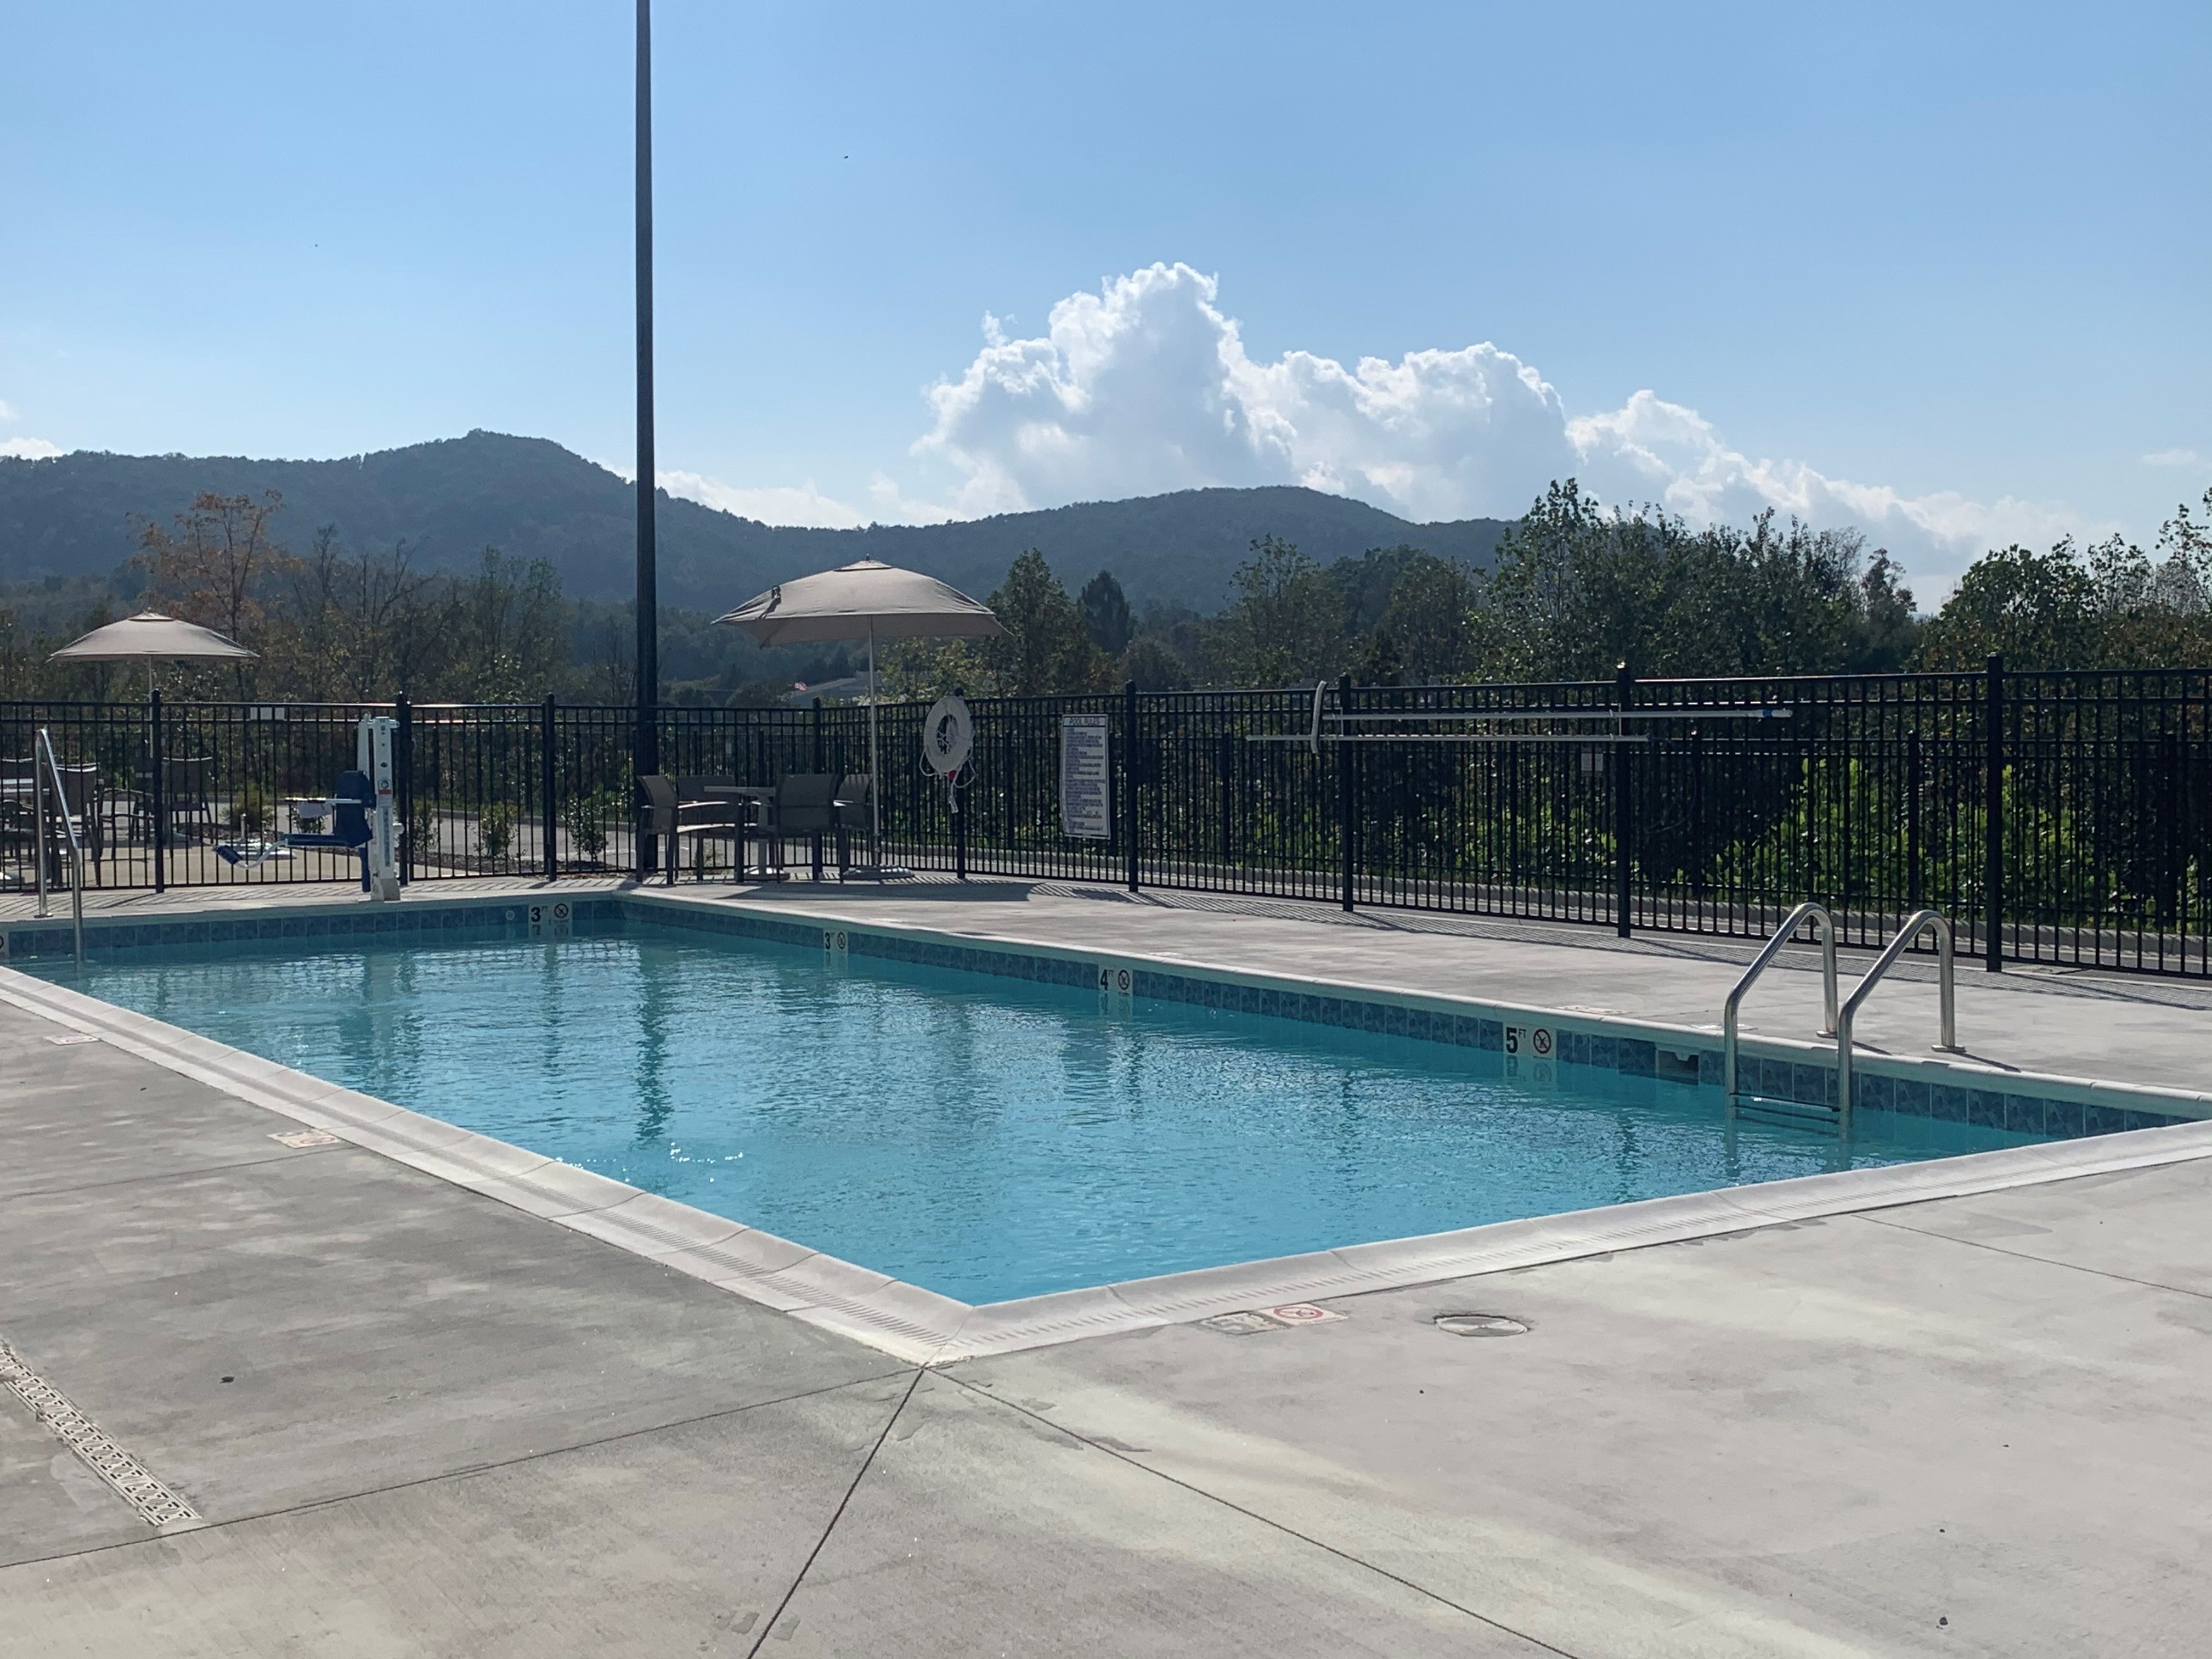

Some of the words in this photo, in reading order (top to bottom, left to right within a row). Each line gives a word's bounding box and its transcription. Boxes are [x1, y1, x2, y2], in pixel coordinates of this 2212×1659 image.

[531, 906, 541, 922] 3
[825, 932, 831, 950] 3
[1101, 969, 1108, 991] 4
[1506, 1026, 1518, 1053] 5
[1519, 1028, 1527, 1038] FT
